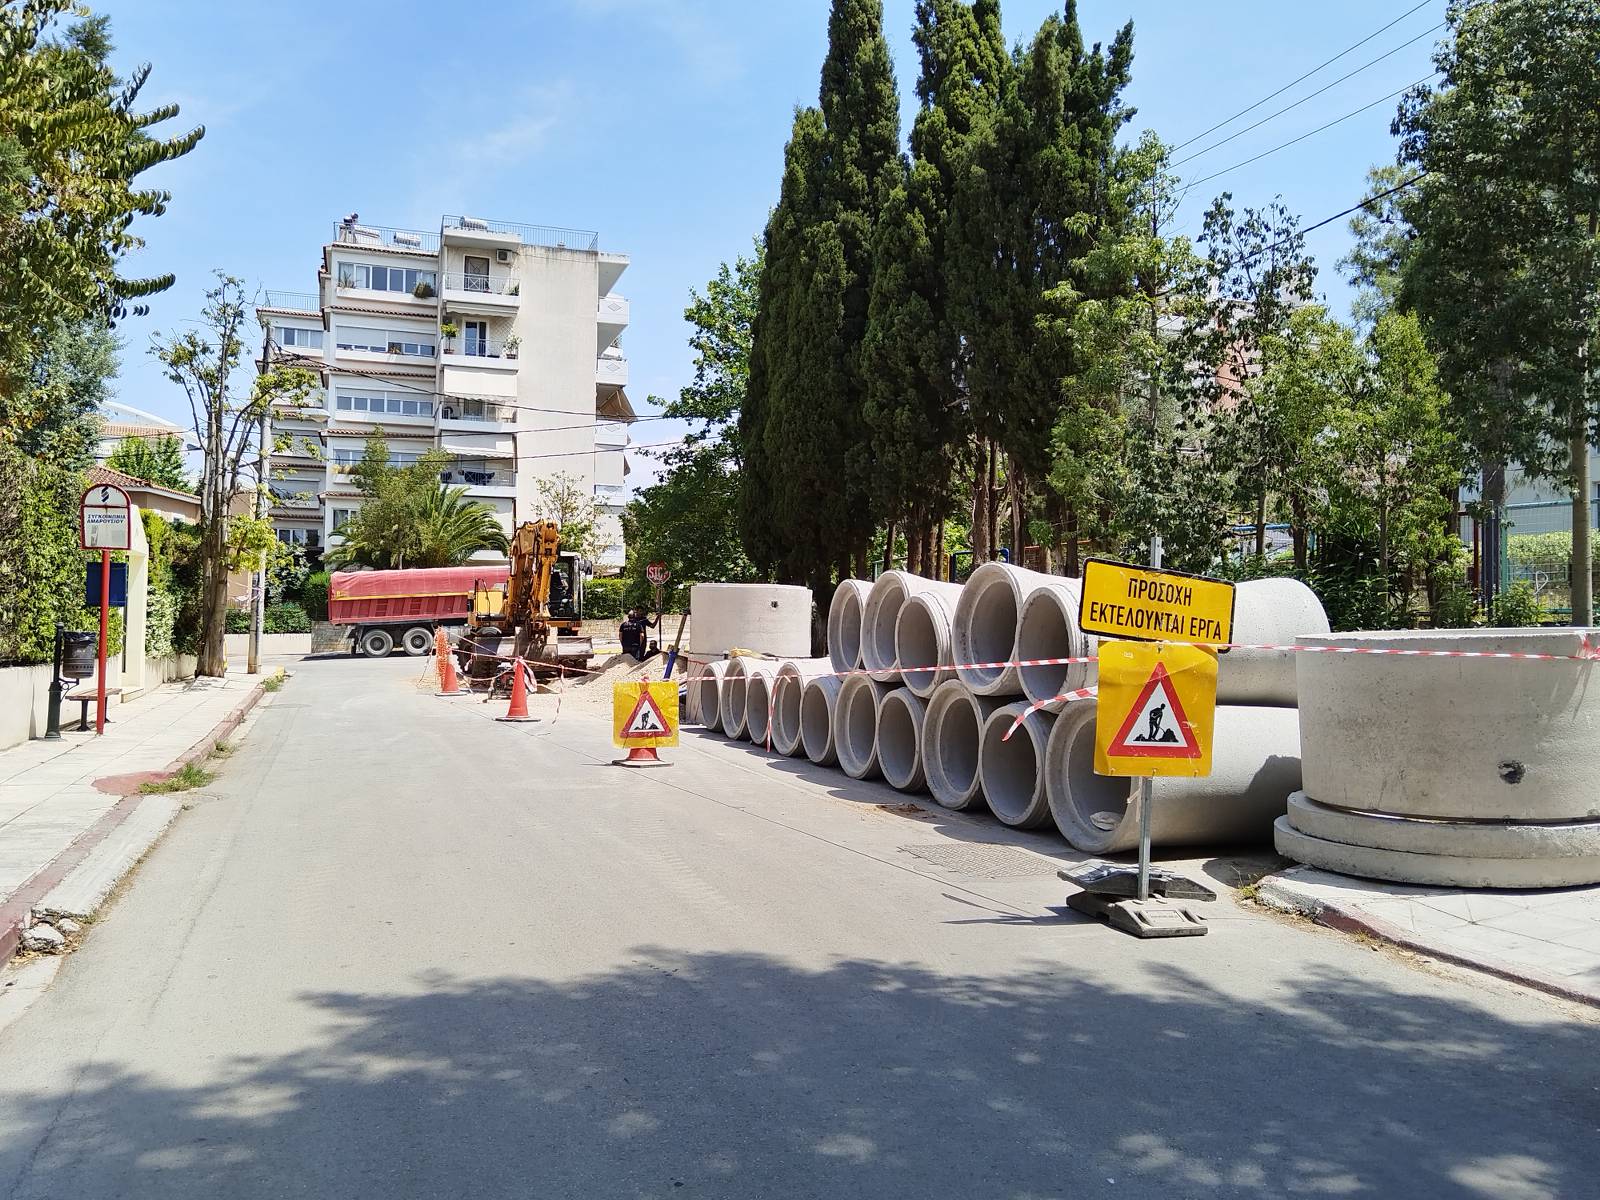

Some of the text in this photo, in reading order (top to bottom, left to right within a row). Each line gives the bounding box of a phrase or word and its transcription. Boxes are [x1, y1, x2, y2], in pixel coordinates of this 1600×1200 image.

[1127, 577, 1192, 607] ΠΡΟΣΟΧΗ
[1089, 601, 1222, 641] ΕΚΤΕΛΟΥΝΤΑΙ ΕΡΓΑ
